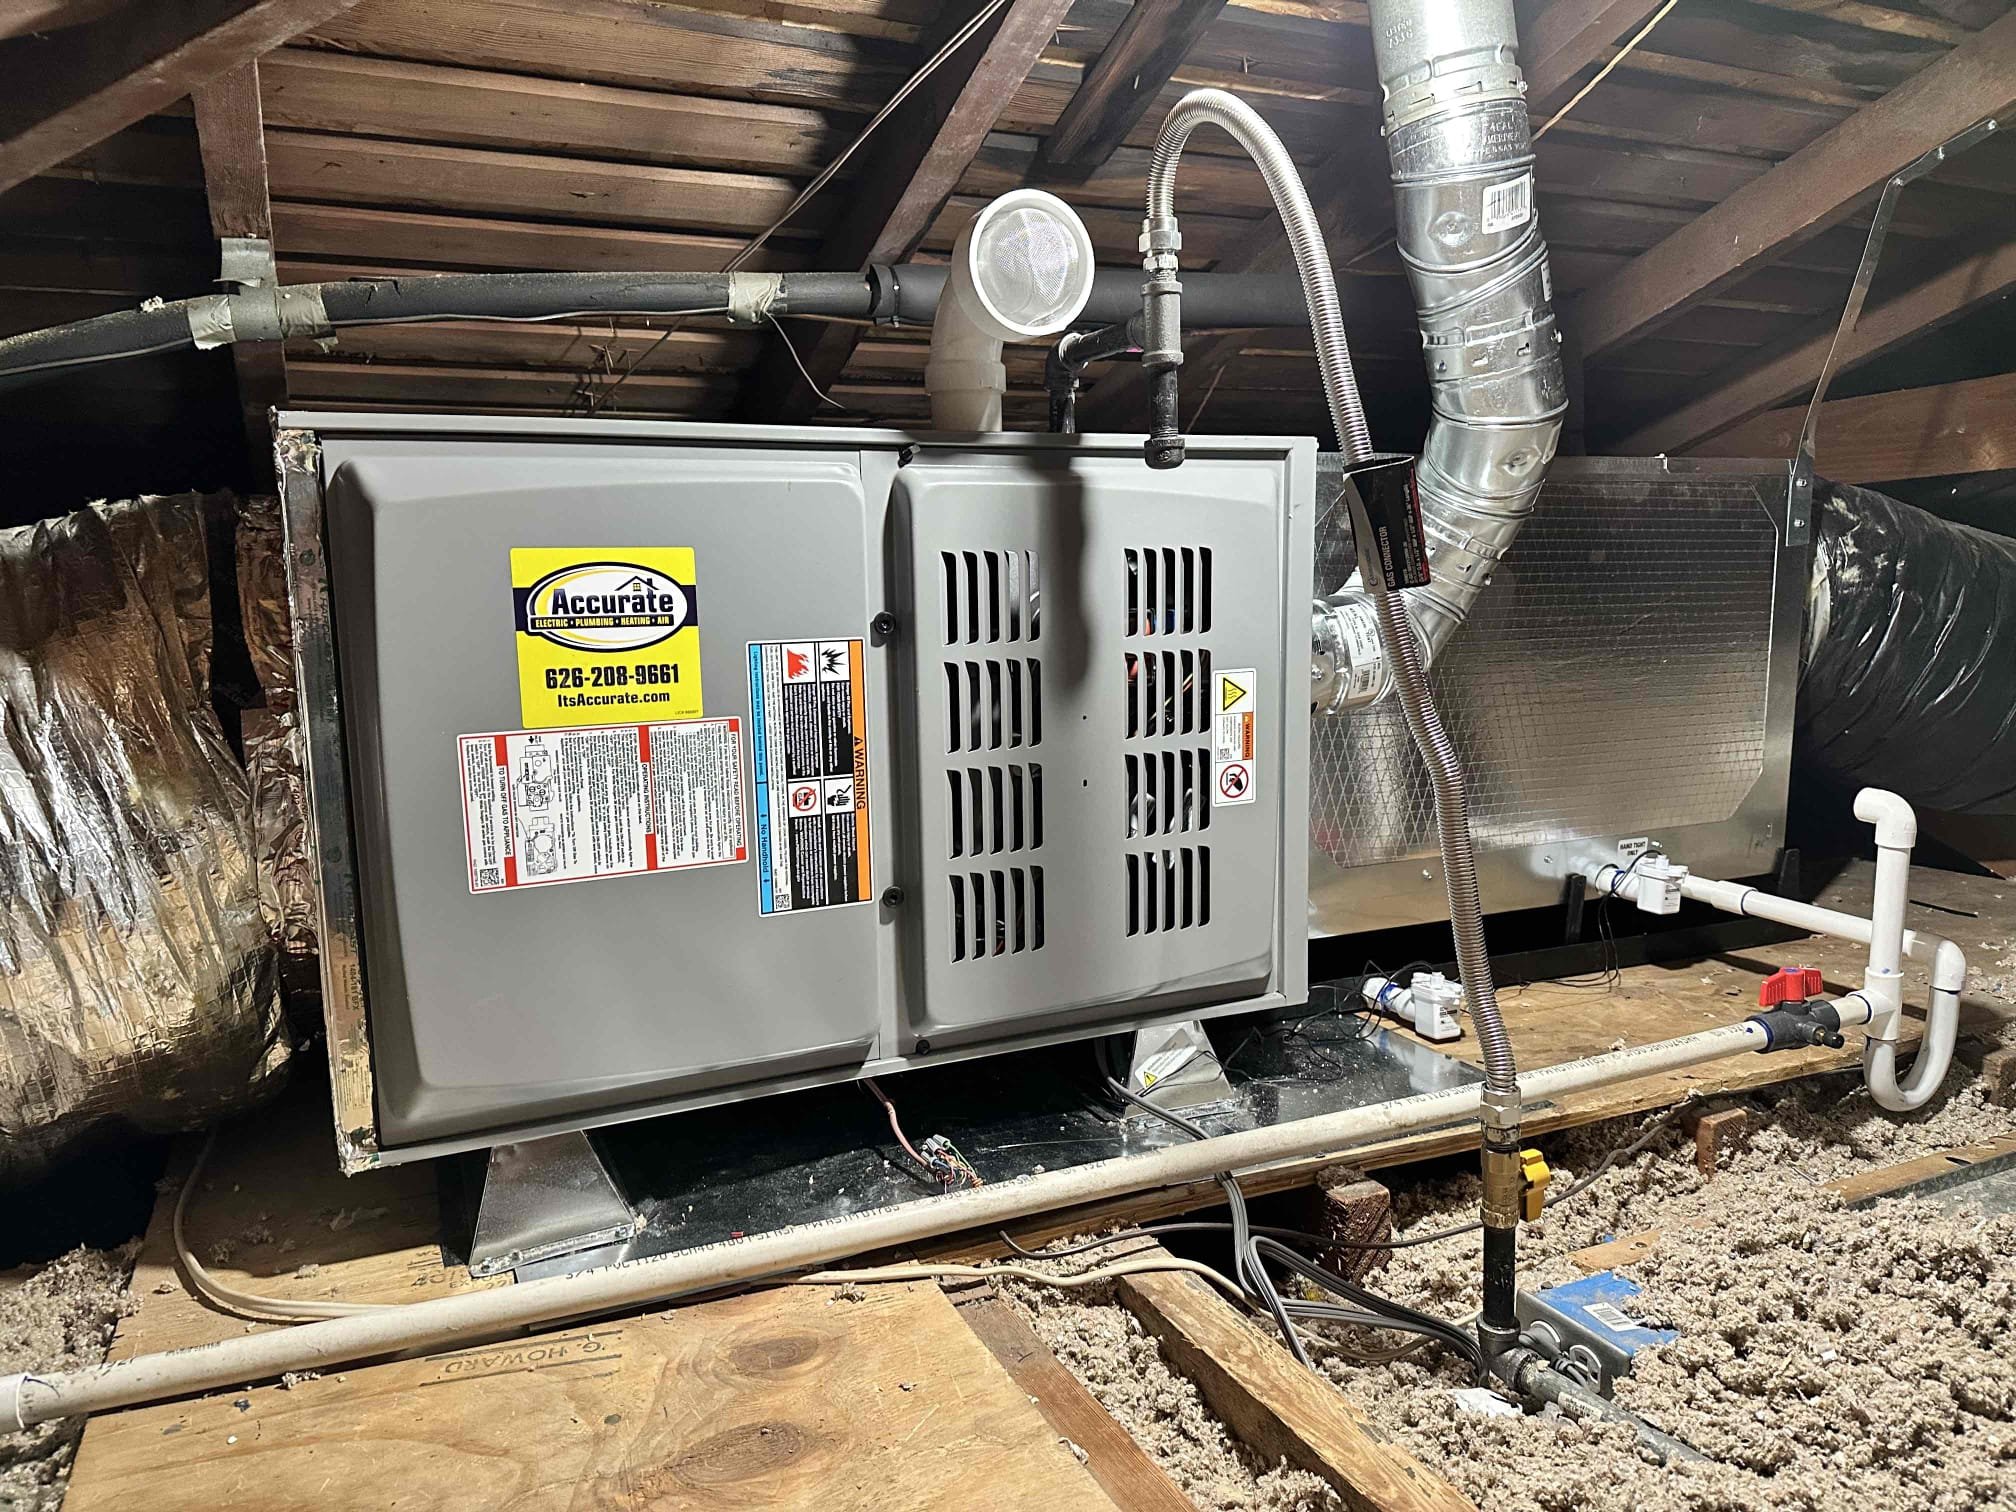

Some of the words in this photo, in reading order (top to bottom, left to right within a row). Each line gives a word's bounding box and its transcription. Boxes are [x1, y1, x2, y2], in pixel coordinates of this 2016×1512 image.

[1379, 526, 1393, 570] CONNECTOR
[1386, 571, 1396, 587] GAS
[552, 588, 674, 615] Accurate
[536, 619, 568, 628] ELECTRIC
[576, 617, 614, 627] PLUMBING
[621, 617, 650, 625] HEATING
[657, 616, 669, 624] AIR
[545, 664, 679, 689] 626-208-9661
[558, 692, 670, 707] ItsAccurate.com
[641, 764, 649, 794] OPERATING
[854, 748, 866, 810] WARNING
[498, 767, 505, 775] TO
[503, 825, 511, 856] APPLIANCE
[643, 795, 652, 833] INSTRUCTIONS
[761, 824, 767, 835] No
[761, 837, 769, 873] Handhold
[445, 1346, 568, 1374] HOWARD
